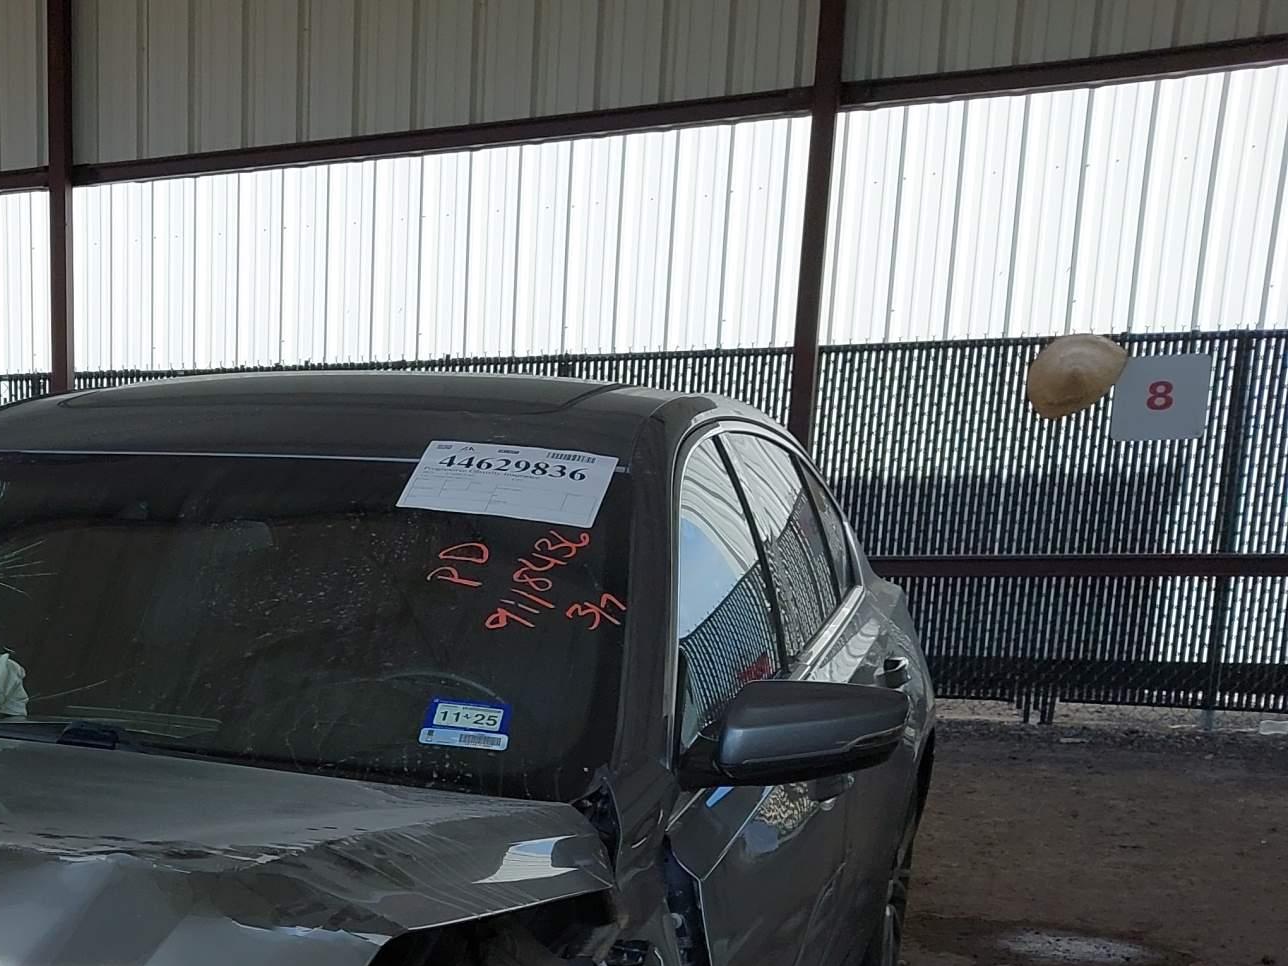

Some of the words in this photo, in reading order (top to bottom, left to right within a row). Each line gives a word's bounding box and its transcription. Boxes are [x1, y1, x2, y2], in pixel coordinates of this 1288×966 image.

[1145, 380, 1174, 411] 8
[438, 454, 590, 481] 44629836
[440, 710, 461, 722] 11
[473, 713, 499, 727] 25
